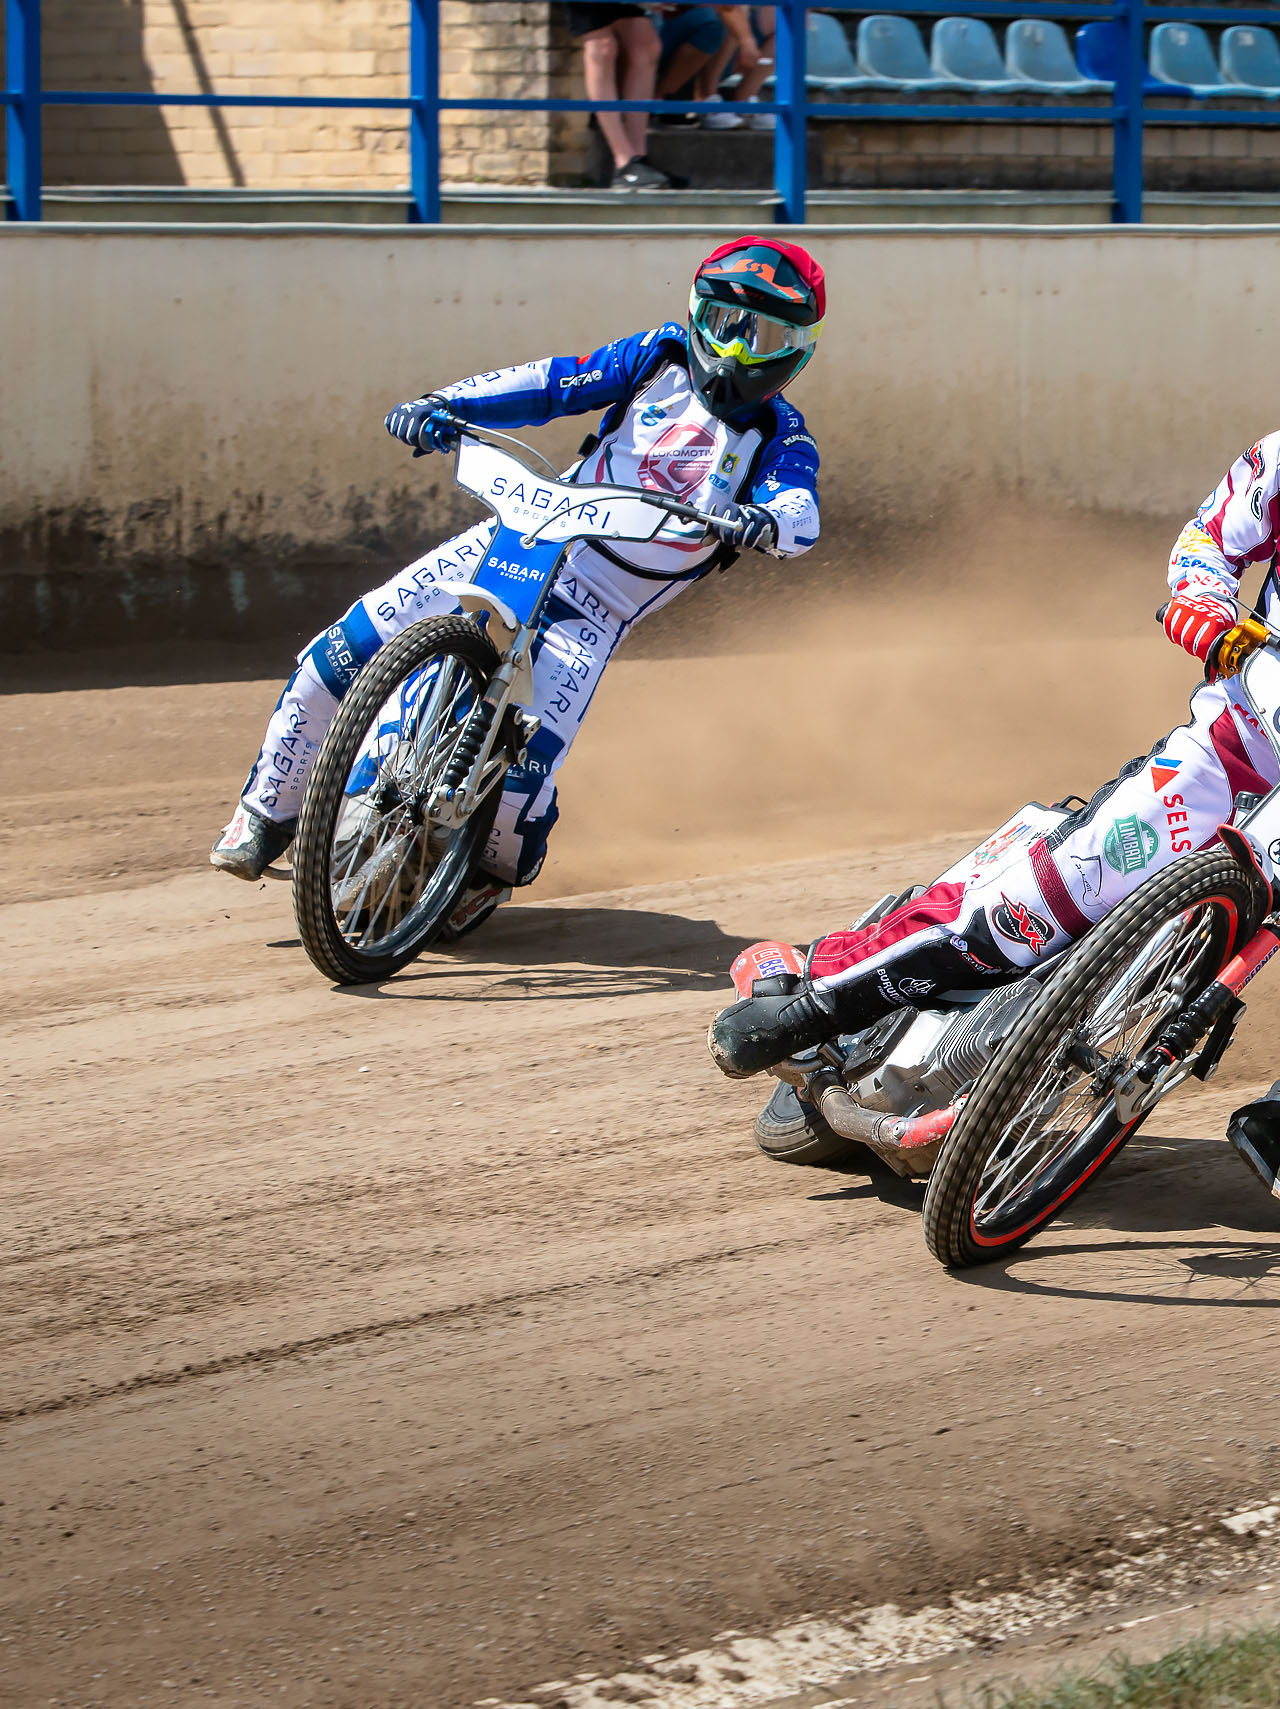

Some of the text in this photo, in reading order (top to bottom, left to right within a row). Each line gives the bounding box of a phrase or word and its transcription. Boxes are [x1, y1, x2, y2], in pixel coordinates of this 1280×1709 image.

[652, 449, 716, 458] LOKOMOTIV
[513, 506, 567, 528] SPORS
[328, 626, 359, 680] SAGA
[1119, 822, 1144, 869] LIMBAŽU
[1163, 793, 1192, 853] SELS
